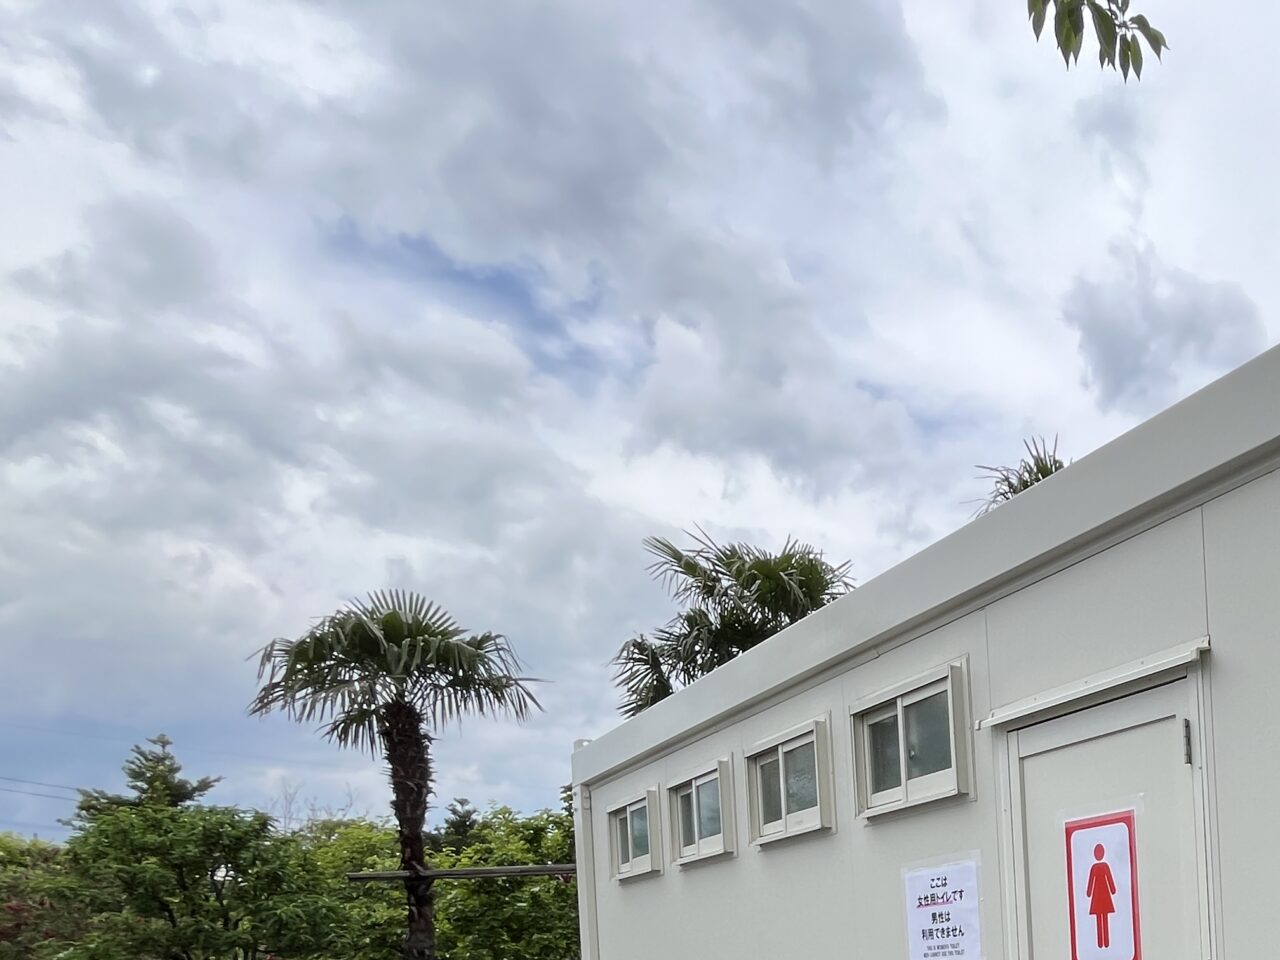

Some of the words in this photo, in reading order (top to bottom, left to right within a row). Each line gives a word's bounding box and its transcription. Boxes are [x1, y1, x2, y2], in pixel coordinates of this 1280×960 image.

[930, 876, 948, 889] ここは
[917, 889, 965, 907] 女性用トイレです
[931, 911, 951, 925] 男性は
[922, 925, 965, 941] 利用できません
